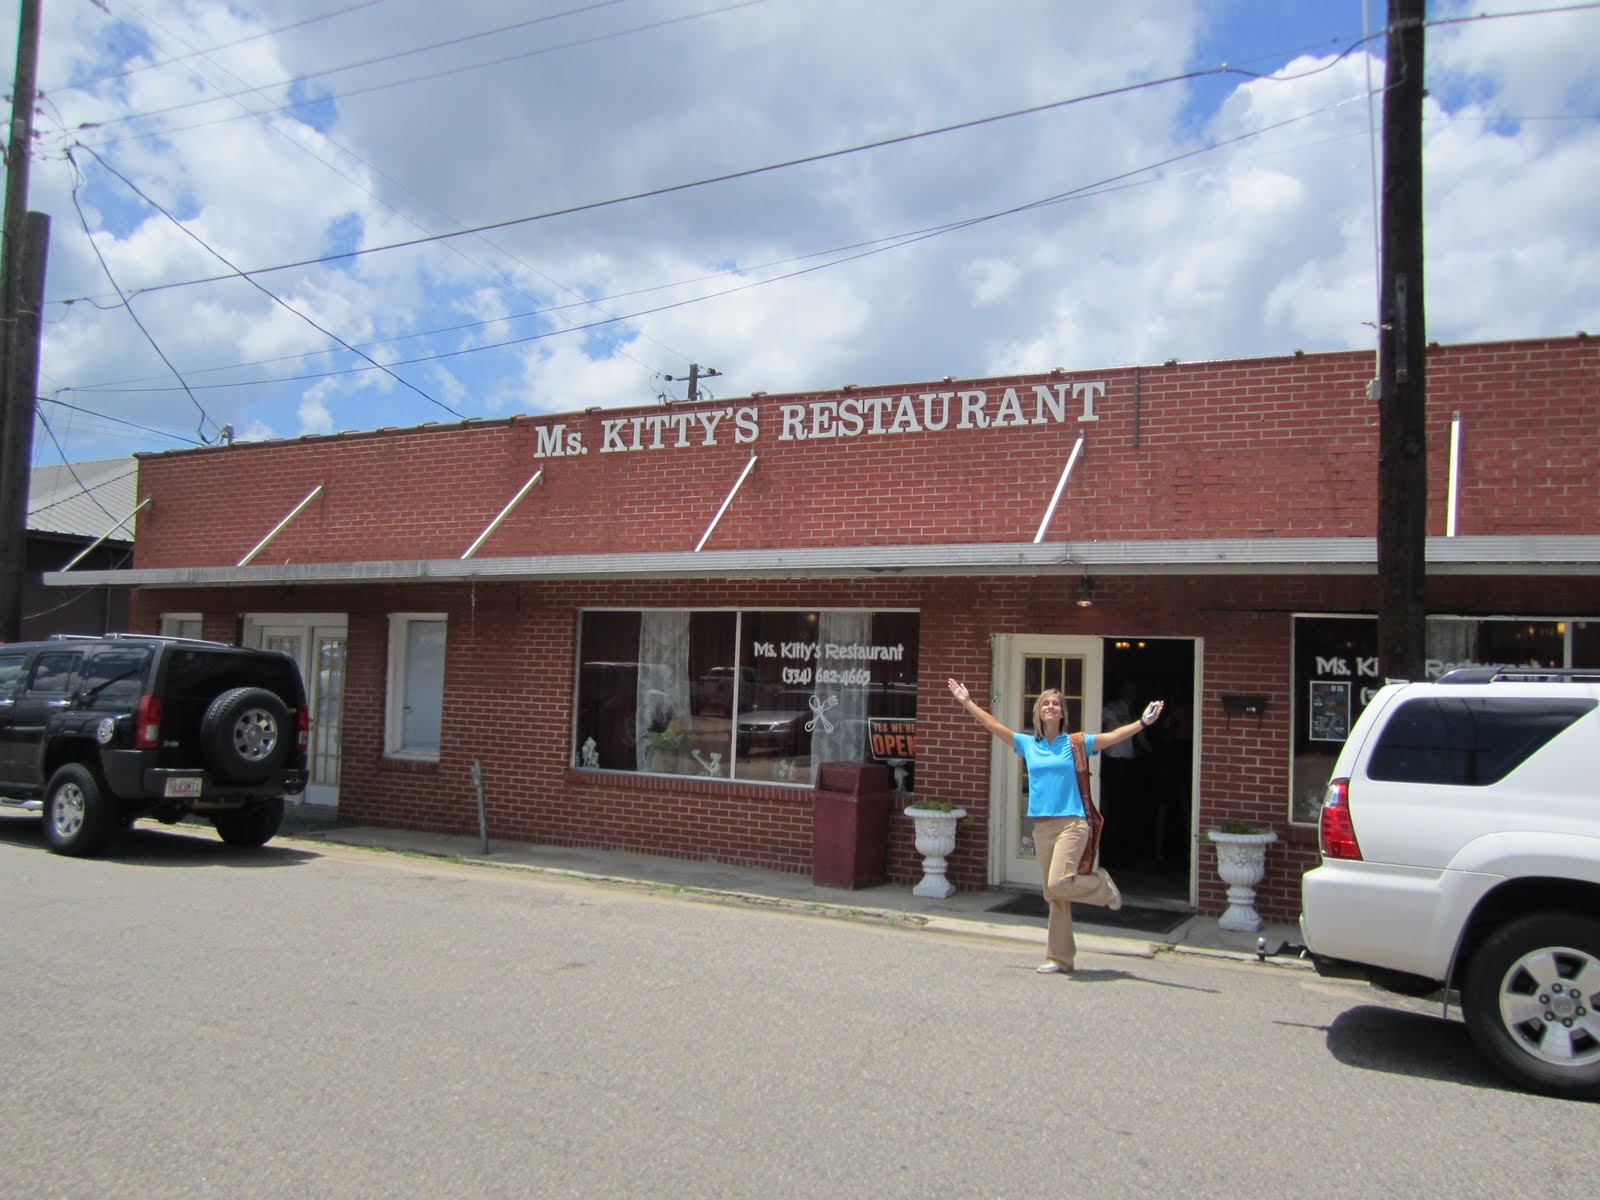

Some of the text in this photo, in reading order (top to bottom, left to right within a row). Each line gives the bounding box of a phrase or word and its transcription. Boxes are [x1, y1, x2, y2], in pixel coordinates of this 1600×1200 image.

[534, 381, 1106, 458] Ms. KITTY'S RESTAURANT
[753, 641, 904, 662] Ms. Kitty's Restaurant
[1315, 656, 1352, 676] Ms.
[782, 667, 871, 686] (334) 682-4665
[873, 722, 916, 733] YES WE'RE
